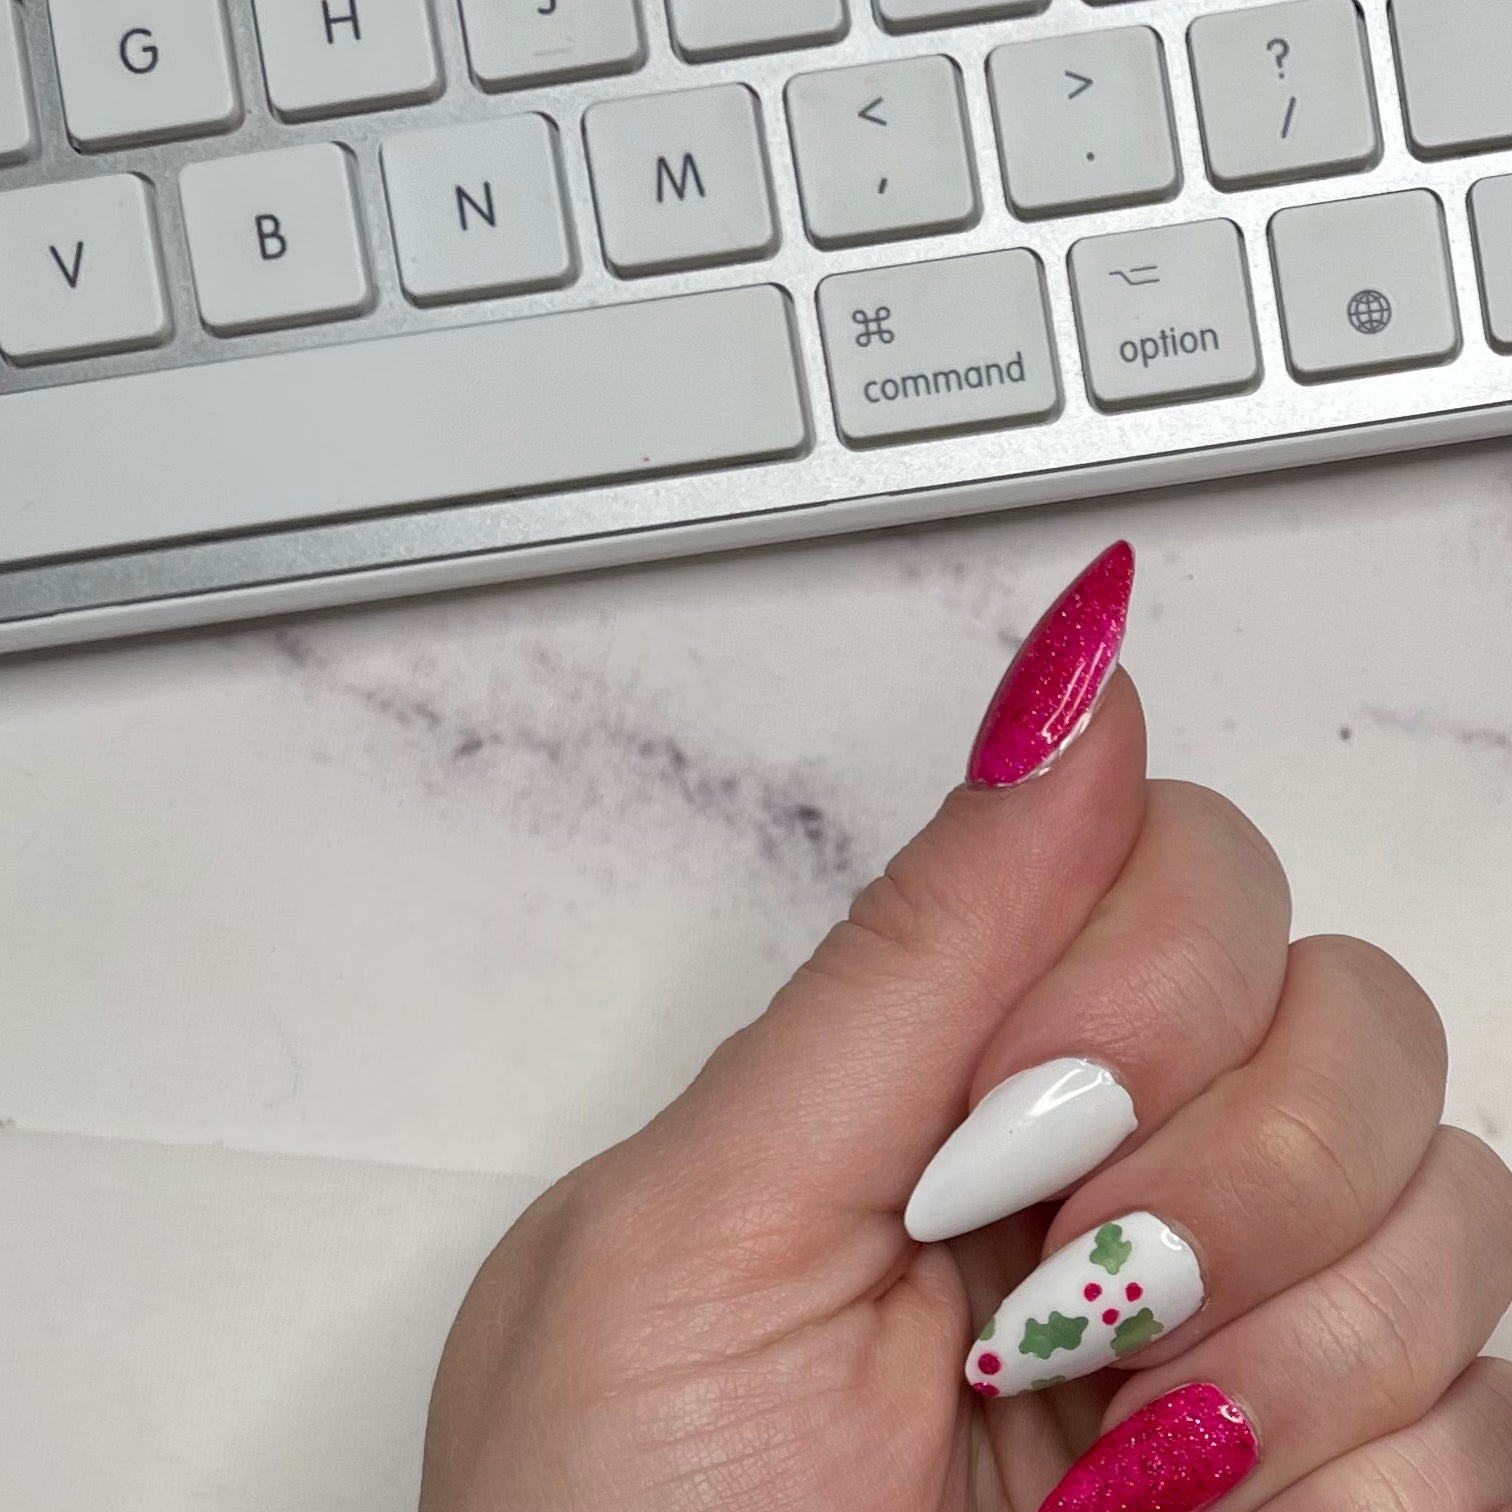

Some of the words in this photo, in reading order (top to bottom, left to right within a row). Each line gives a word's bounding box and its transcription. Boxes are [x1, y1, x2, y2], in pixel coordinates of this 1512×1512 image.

[321, 0, 361, 45] H
[119, 27, 159, 75] G
[1266, 38, 1290, 79] ?
[1281, 96, 1297, 139] /
[656, 152, 706, 204] M
[455, 181, 496, 231] N
[254, 213, 287, 261] B
[49, 241, 84, 289] V
[1118, 325, 1220, 369] option
[862, 352, 1026, 404] command
